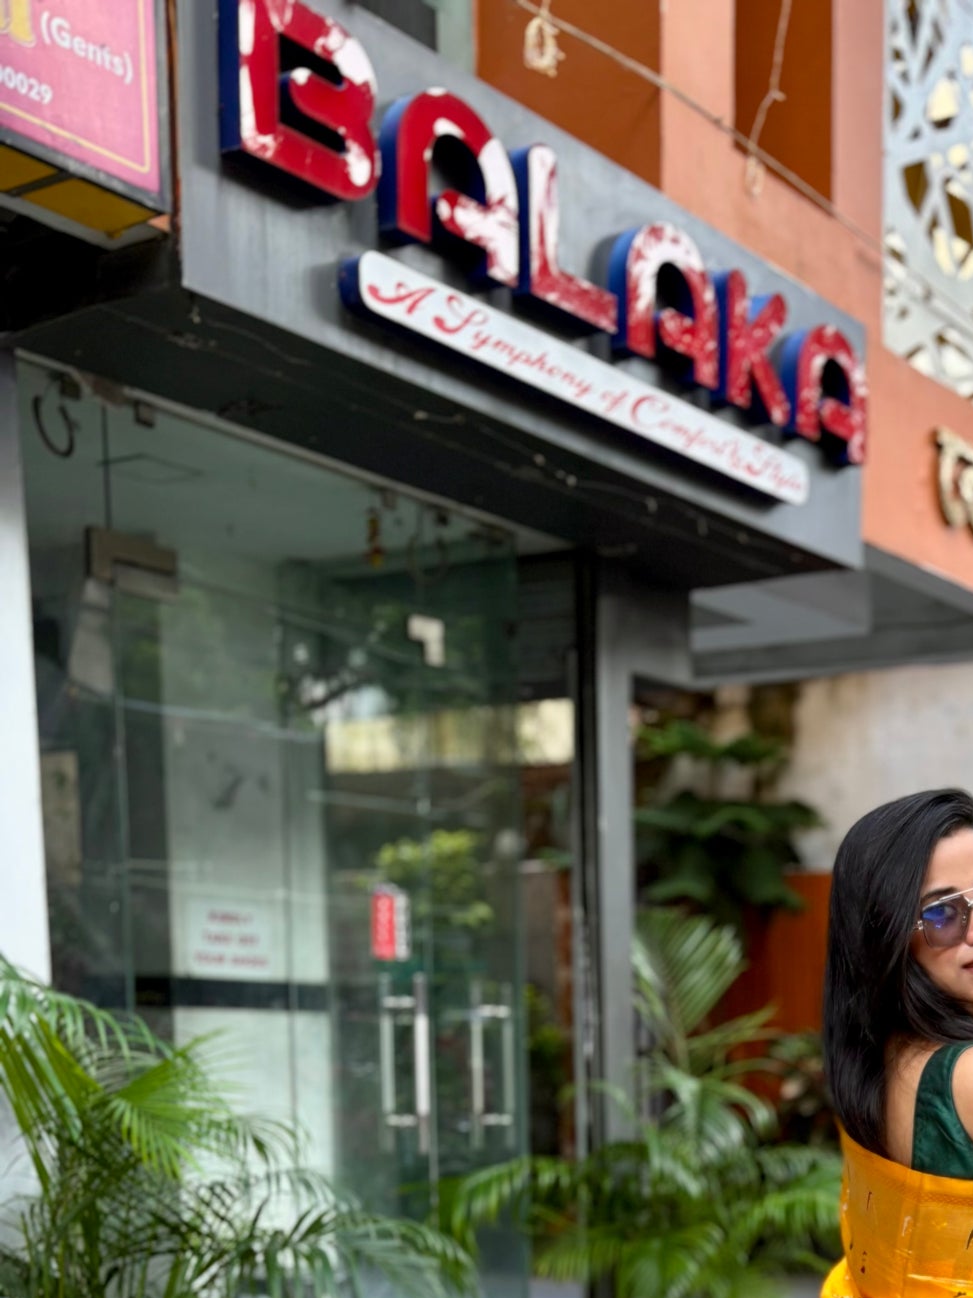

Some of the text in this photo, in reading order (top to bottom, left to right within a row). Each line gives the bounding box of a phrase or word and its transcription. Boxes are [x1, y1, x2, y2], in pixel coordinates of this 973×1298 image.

[0, 63, 53, 104] 0029
[41, 10, 134, 86] (Gents)
[221, 0, 869, 468] BALAKA
[366, 281, 436, 316] A
[432, 294, 594, 396] Symphony
[600, 388, 629, 415] of
